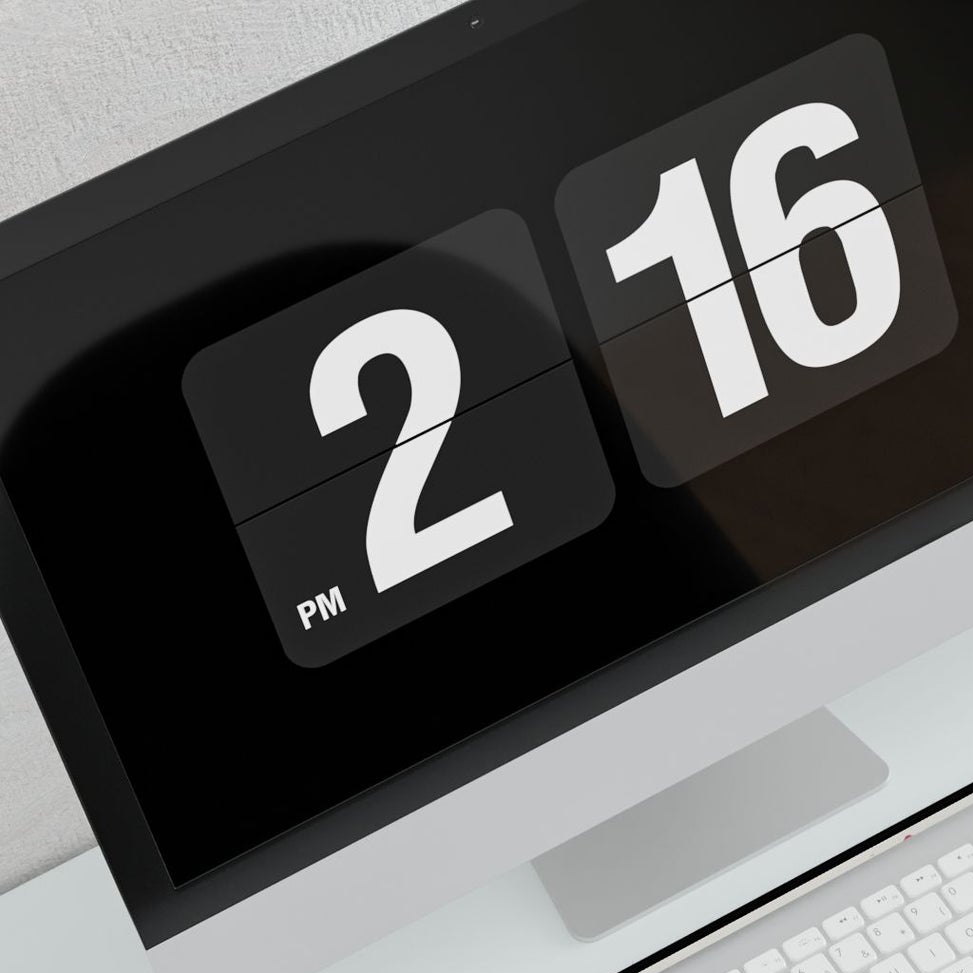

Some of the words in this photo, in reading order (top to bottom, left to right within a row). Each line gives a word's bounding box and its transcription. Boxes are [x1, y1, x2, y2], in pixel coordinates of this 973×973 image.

[606, 102, 900, 418] 16
[309, 309, 514, 594] 2
[296, 585, 347, 631] PM
